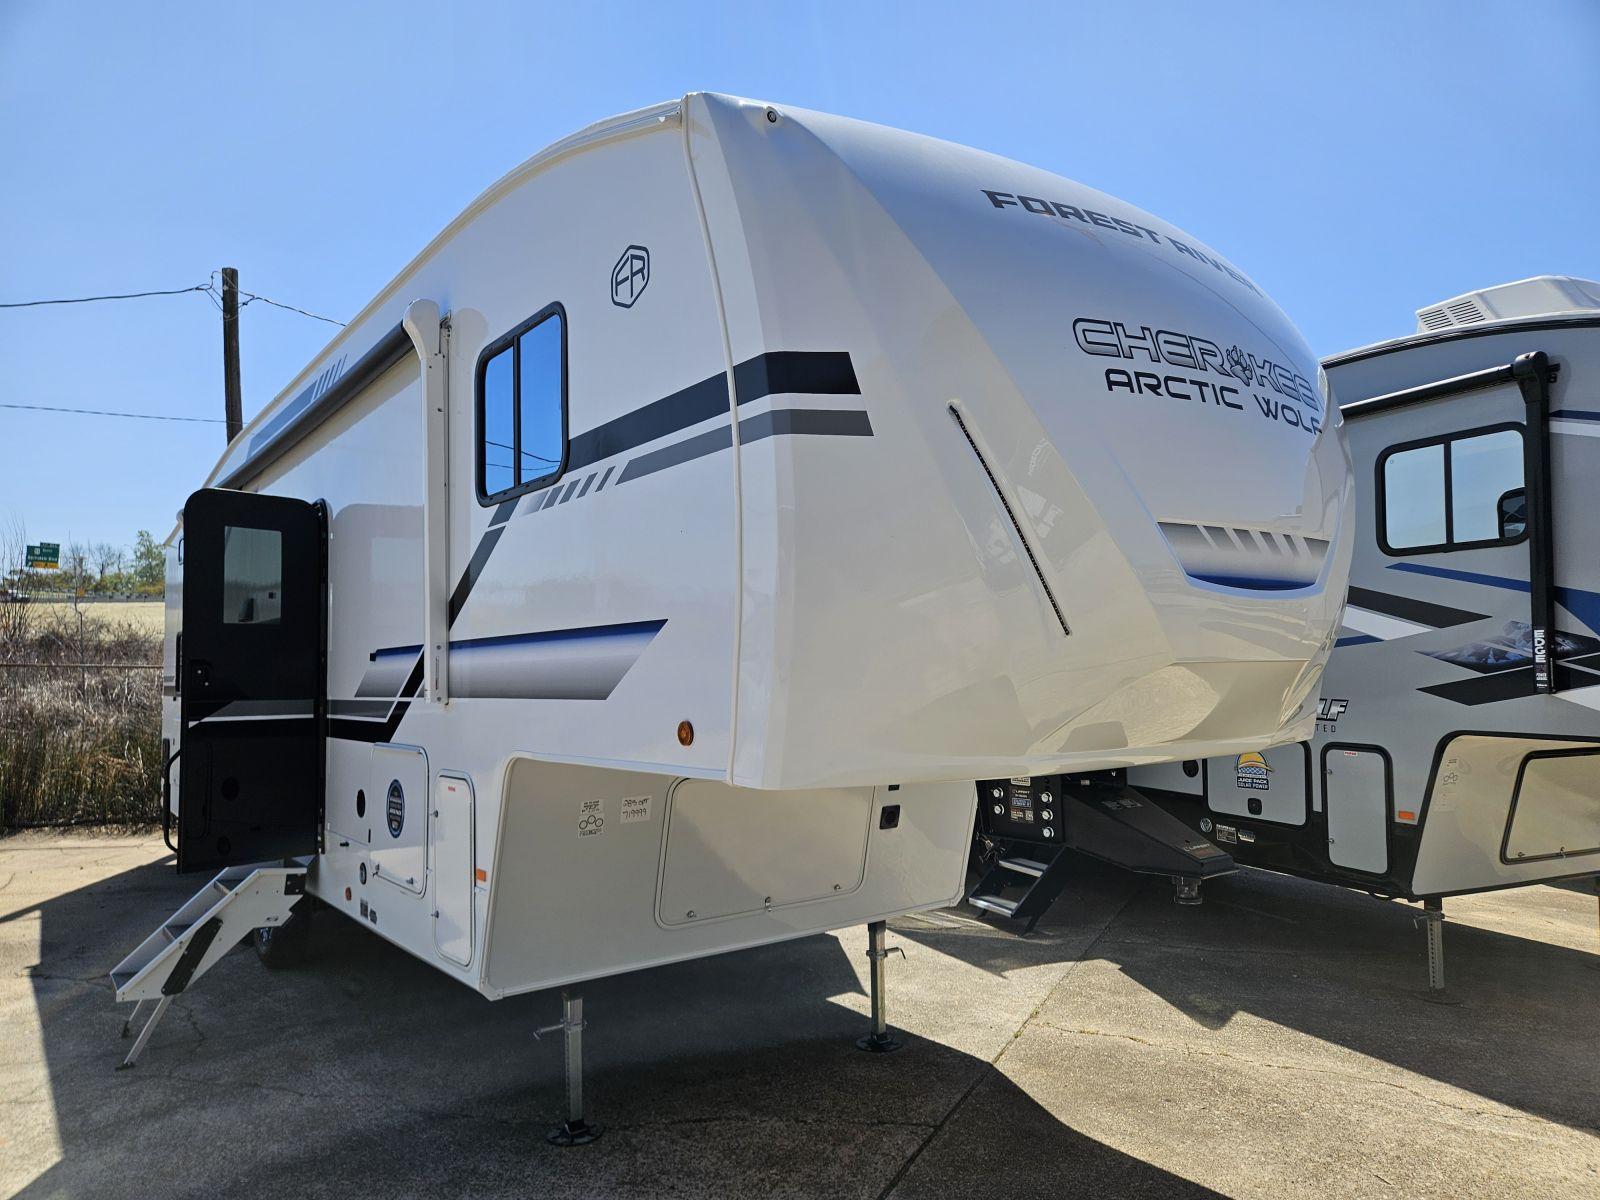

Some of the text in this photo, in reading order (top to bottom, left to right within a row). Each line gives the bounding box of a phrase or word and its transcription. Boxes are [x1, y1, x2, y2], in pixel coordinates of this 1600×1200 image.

[980, 189, 1161, 245] FOREST
[1104, 368, 1322, 436] ARCTIC WOLF
[1534, 630, 1546, 662] EDGE
